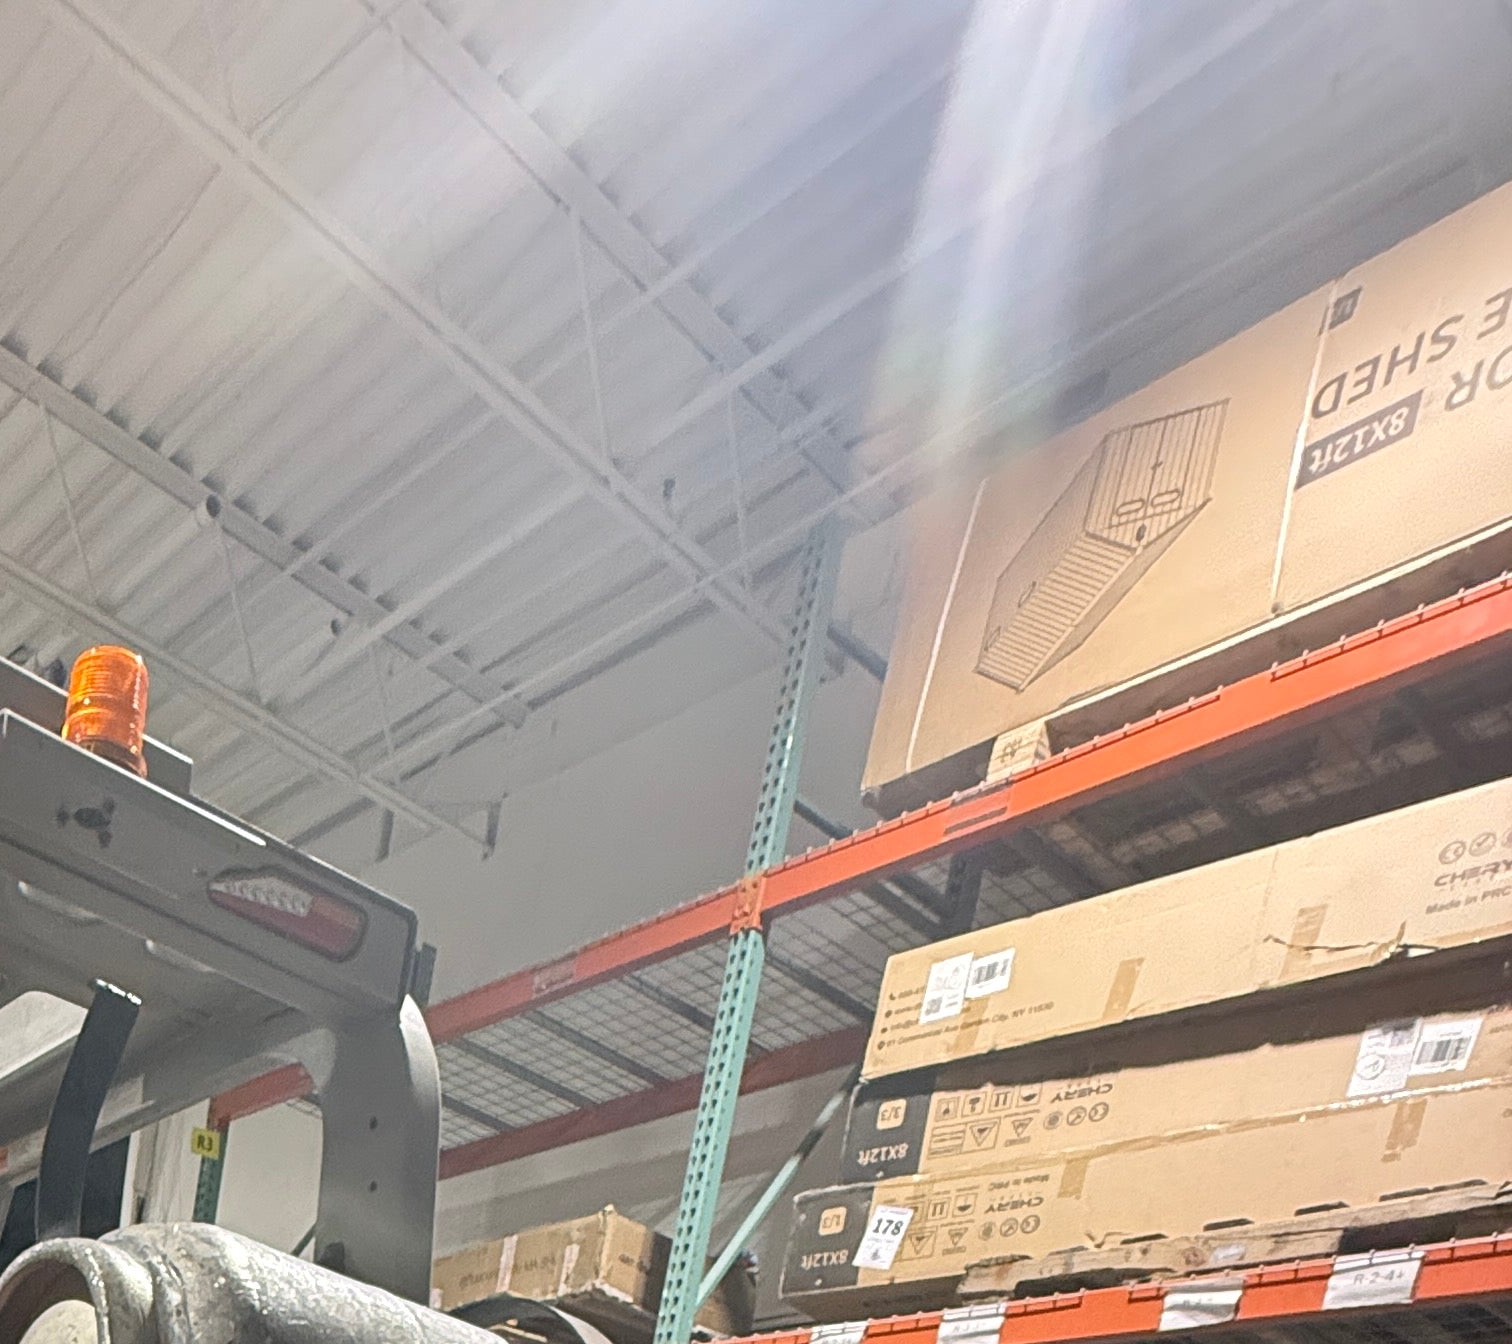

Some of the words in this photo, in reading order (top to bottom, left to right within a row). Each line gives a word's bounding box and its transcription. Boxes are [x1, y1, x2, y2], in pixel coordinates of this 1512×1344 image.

[1311, 314, 1465, 419] SHED
[1308, 406, 1410, 473] 8X12ft
[1049, 1082, 1114, 1104] CHERY
[196, 1134, 214, 1152] R3
[856, 1142, 909, 1167] 8X12ft
[1008, 1178, 1020, 1188] in
[1021, 1173, 1051, 1185] Made
[984, 1196, 1045, 1214] CHERY
[872, 1217, 904, 1236] 178
